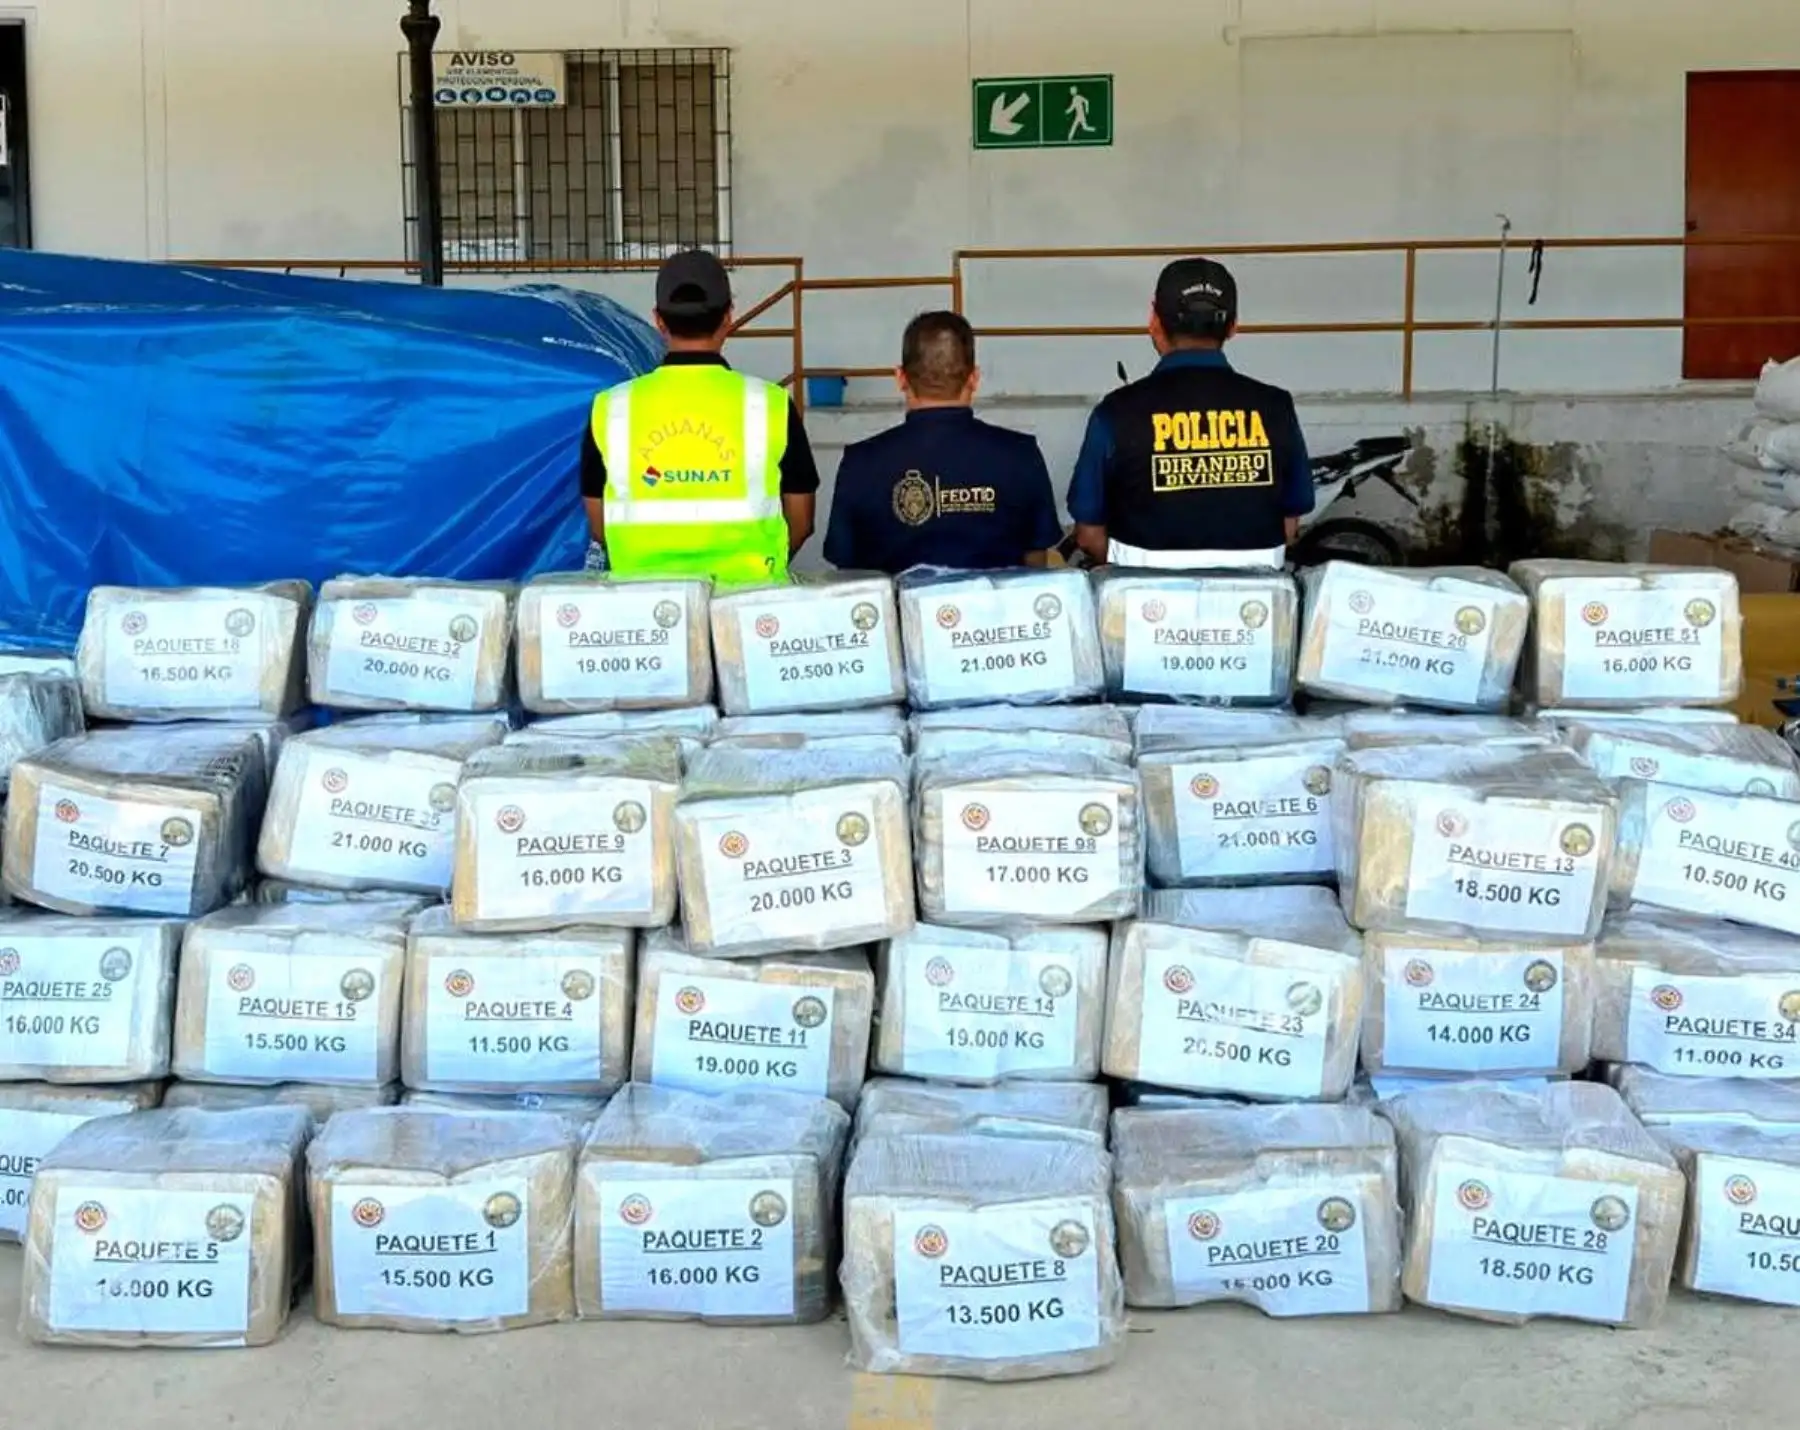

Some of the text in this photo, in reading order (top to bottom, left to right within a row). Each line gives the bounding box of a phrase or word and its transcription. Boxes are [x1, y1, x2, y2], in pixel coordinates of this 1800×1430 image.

[450, 52, 515, 66] AVISO
[639, 418, 736, 462] ADUANAS
[1152, 410, 1270, 451] POLICIA
[1159, 453, 1266, 474] DIRANDRO
[664, 470, 732, 482] SUNAT
[1165, 471, 1260, 486] DIVINESP
[360, 630, 439, 653] PAQUETE
[568, 630, 668, 645] PAQUETE 50
[850, 632, 869, 647] 42
[951, 623, 1052, 644] PAQUETE 65
[1154, 629, 1233, 643] PAQUETE
[1357, 619, 1444, 646] PAQUETE
[1595, 628, 1700, 644] PAQUETE 51
[133, 638, 217, 653] PAQUETE
[364, 659, 450, 681] 20.000 KG
[577, 656, 662, 672] 19.000 KG
[780, 659, 865, 681] 20.500 KG
[960, 651, 1047, 673] 21.000 KG
[1161, 656, 1247, 670] 19.000 KG
[1425, 657, 1456, 676] KG
[1603, 656, 1692, 672] 16.000 KG
[141, 666, 232, 681] 16.500 KG
[331, 800, 415, 823] PAQUETE
[1306, 798, 1318, 812] 6
[69, 830, 169, 857] PAQUETE 7
[331, 832, 427, 858] 21.000 KG
[517, 835, 625, 852] PAQUETE 9
[976, 837, 1069, 851] PAQUETE
[1218, 830, 1317, 849] 21.000 KG
[1449, 844, 1575, 872] PAQUETE 13
[1680, 829, 1800, 872] PAQUETE 40
[69, 859, 162, 886] 20.500 KG
[743, 849, 852, 878] PAQUETE 3
[520, 866, 622, 887] 16.000 KG
[986, 866, 1089, 883] 17.000 KG
[1683, 864, 1786, 901] 10.500 KG
[750, 882, 853, 912] 20.000 KG
[1455, 878, 1561, 906] 18.500 KG
[3, 981, 113, 997] PAQUETE 25
[239, 997, 357, 1018] PAQUETE 15
[464, 1001, 573, 1018] PAQUETE 4
[939, 993, 1055, 1013] PAQUETE 14
[1418, 992, 1541, 1011] PAQUETE 24
[5, 1016, 100, 1034] 16.000 KG
[689, 1019, 807, 1045] PAQUETE 11
[1428, 1025, 1531, 1044] 14.000 KG
[1665, 1016, 1796, 1039] PAQUETE 34
[245, 1033, 346, 1053] 15.500 KG
[468, 1036, 569, 1053] 11.500 KG
[946, 1029, 1045, 1049] 19.000 KG
[1183, 1037, 1292, 1067] 20.500 KG
[1673, 1048, 1784, 1069] 11.000 KG
[695, 1056, 797, 1077] 19.000 KG
[375, 1232, 496, 1253] PAQUETE 1
[643, 1229, 763, 1249] PAQUETE 2
[1473, 1217, 1608, 1250] PAQUETE 28
[205, 1242, 218, 1259] 5
[1207, 1235, 1339, 1263] PAQUETE 20
[380, 1269, 494, 1288] 15.500 KG
[647, 1265, 760, 1285] 16.000 KG
[940, 1259, 1066, 1284] PAQUETE 8
[1297, 1270, 1333, 1287] KG
[1478, 1258, 1593, 1286] 18.500 KG
[177, 1280, 213, 1297] KG
[946, 1298, 1064, 1325] 13.500 KG
